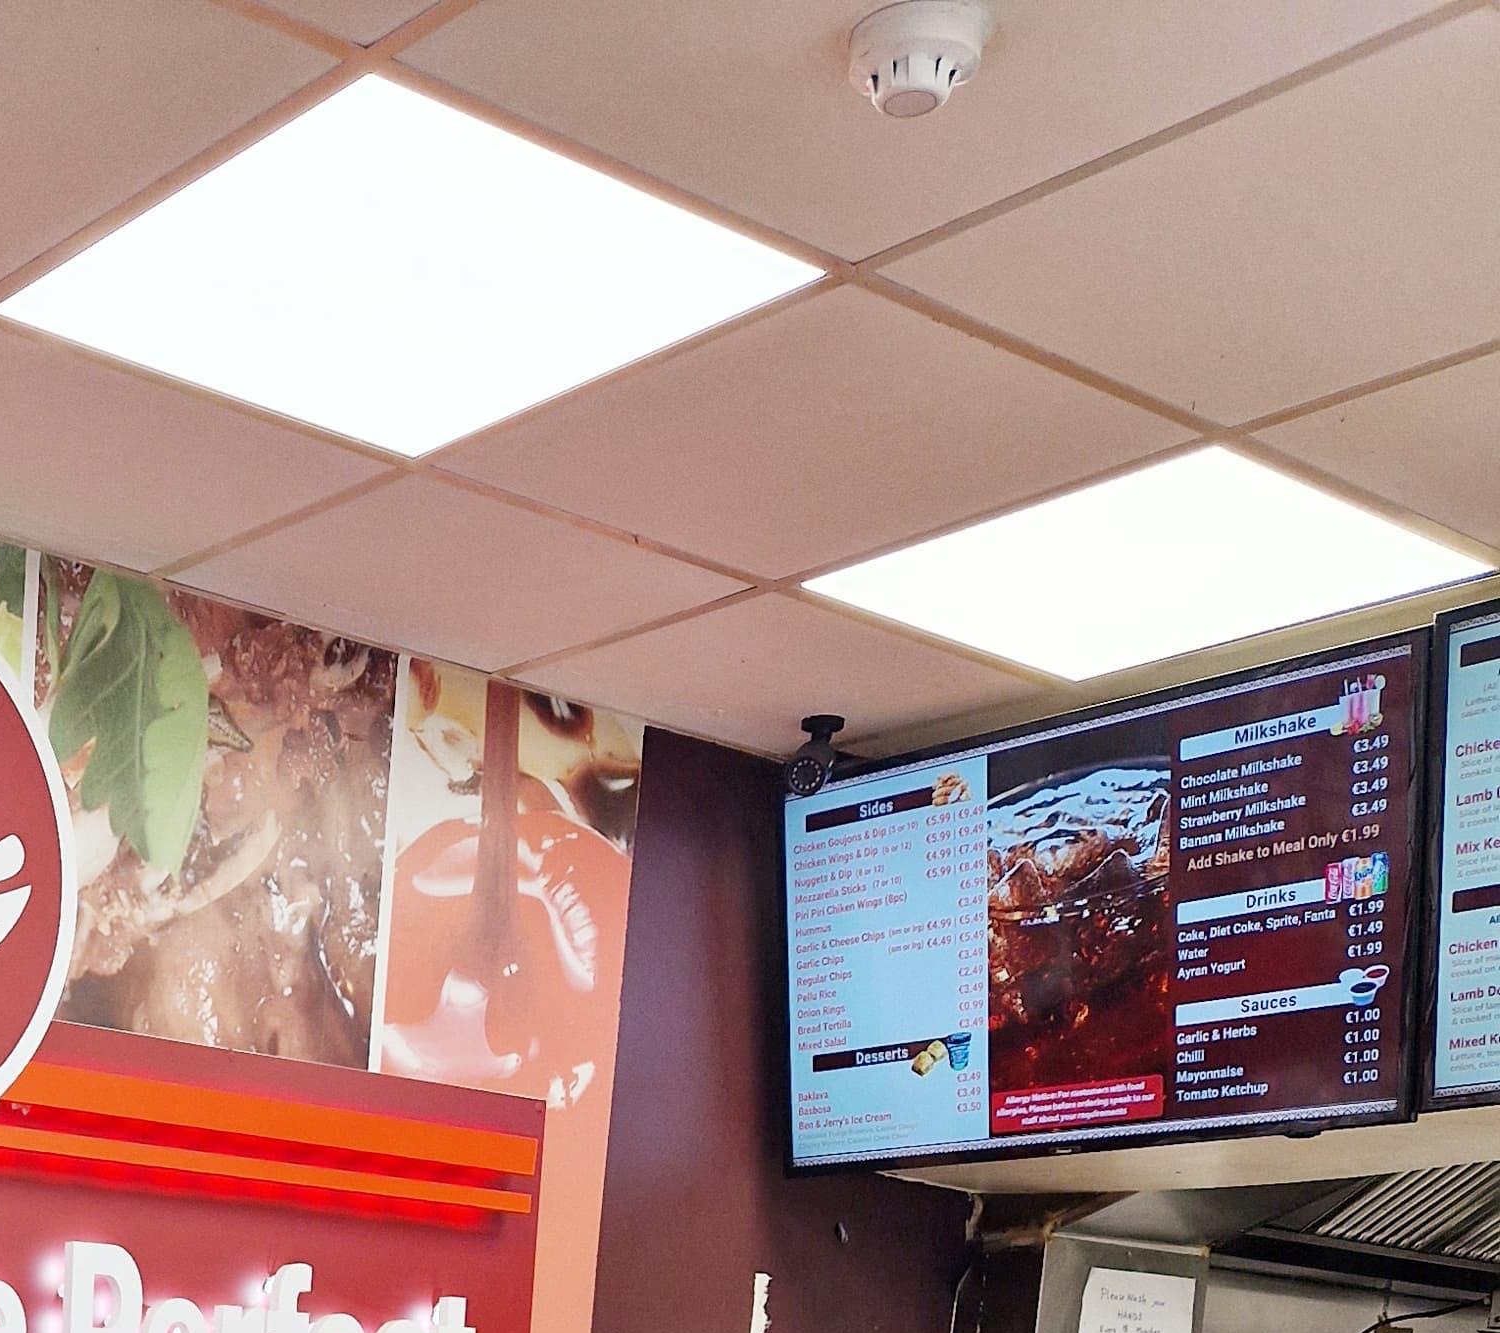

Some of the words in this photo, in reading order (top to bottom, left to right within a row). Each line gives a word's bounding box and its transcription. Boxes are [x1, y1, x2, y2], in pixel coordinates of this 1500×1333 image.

[1234, 716, 1317, 745] Milkshake
[1181, 768, 1238, 789] Chocolate
[1241, 754, 1302, 777] Milkshake
[1353, 734, 1389, 753] €3.49
[1180, 795, 1206, 810] Mint
[1209, 781, 1269, 803] Milkshake
[1353, 755, 1388, 774] €3.49
[1456, 789, 1492, 806] Lamb
[859, 800, 894, 818] Sides
[1180, 807, 1243, 829] Strawberry
[1245, 795, 1306, 817] Milkshake
[1352, 777, 1388, 795] €3.49
[794, 840, 826, 855] Chicken
[828, 832, 862, 848] Goujons
[864, 830, 870, 839] &
[872, 826, 886, 839] Dip
[926, 812, 950, 827] €5.99
[958, 805, 984, 820] €9.49
[1179, 831, 1222, 850] Banana
[1225, 820, 1285, 840] Milkshake
[1351, 799, 1387, 816] €3.49
[794, 857, 826, 871] Chicken
[828, 850, 853, 866] Wings
[855, 848, 862, 858] &
[864, 844, 878, 858] Dip
[926, 830, 951, 844] €5.99
[959, 823, 984, 837] €9.49
[795, 873, 828, 889] Nuggets
[830, 871, 837, 881] &
[838, 868, 852, 882] Dip
[926, 847, 951, 862] €4.99
[959, 841, 984, 855] €7.49
[1187, 855, 1212, 872] Add
[1215, 847, 1254, 867] Shake
[1257, 846, 1270, 858] to
[1273, 836, 1305, 856] Meal
[1308, 831, 1337, 850] Only
[1341, 823, 1380, 843] €1.99
[1456, 842, 1480, 856] Mix
[795, 888, 839, 905] Mozzarella
[841, 883, 867, 896] Sticks
[926, 865, 951, 879] €5.99
[959, 859, 984, 872] €8.49
[795, 907, 810, 921] Piri
[811, 905, 825, 919] Piri
[827, 901, 855, 916] Chiken
[857, 896, 883, 910] Wings
[960, 876, 985, 890] €6.99
[1246, 889, 1296, 909] Drinks
[795, 924, 832, 938] Hummus
[958, 895, 983, 908] €3.49
[796, 941, 819, 954] Garlic
[821, 940, 827, 950] &
[829, 934, 860, 948] Cheese
[862, 931, 885, 944] Chips
[927, 917, 951, 931] €4.99
[959, 911, 984, 925] €5.49
[1178, 928, 1207, 944] Coke,
[1210, 925, 1231, 939] Diet
[1233, 919, 1263, 935] Coke,
[1266, 914, 1301, 930] Sprite,
[1304, 908, 1336, 924] Fanta
[1349, 900, 1384, 917] €1.99
[796, 957, 820, 970] Garlic
[821, 954, 844, 967] Chips
[927, 934, 952, 948] €4.49
[959, 929, 984, 943] €5.49
[1177, 945, 1209, 961] Water
[1348, 920, 1383, 937] €1.49
[1449, 939, 1498, 955] Chicken
[797, 975, 827, 987] Regular
[829, 970, 852, 982] Chips
[958, 948, 983, 961] €3.49
[1177, 965, 1208, 981] Ayran
[1210, 958, 1246, 976] Yogurt
[1347, 941, 1383, 958] €1.99
[797, 1008, 821, 1019] Onion
[823, 1004, 846, 1017] Rings
[958, 983, 983, 994] €3.49
[819, 989, 837, 1000] Rice
[958, 965, 983, 977] €2.49
[1450, 987, 1483, 1002] Lamb
[798, 1024, 821, 1035] Bread
[823, 1019, 852, 1031] Tortilla
[959, 1000, 984, 1011] €0.99
[1241, 995, 1297, 1013] Sauces
[798, 1040, 823, 1051] Mixed
[825, 1036, 847, 1047] Salad
[959, 1017, 984, 1029] €3.49
[1176, 1031, 1209, 1045] Garlic
[1211, 1029, 1220, 1041] &
[1223, 1024, 1258, 1040] Herbs
[1345, 1008, 1381, 1024] €1.00
[1449, 1035, 1486, 1050] Mixed
[856, 1046, 909, 1065] Desserts
[1176, 1050, 1205, 1065] Chilli
[1344, 1028, 1380, 1044] €1.00
[1176, 1066, 1244, 1085] Mayonnaise
[1343, 1049, 1379, 1064] €1.00
[1176, 1087, 1219, 1102] Tomato
[1221, 1082, 1268, 1098] Ketchup
[1343, 1069, 1379, 1085] €1.00
